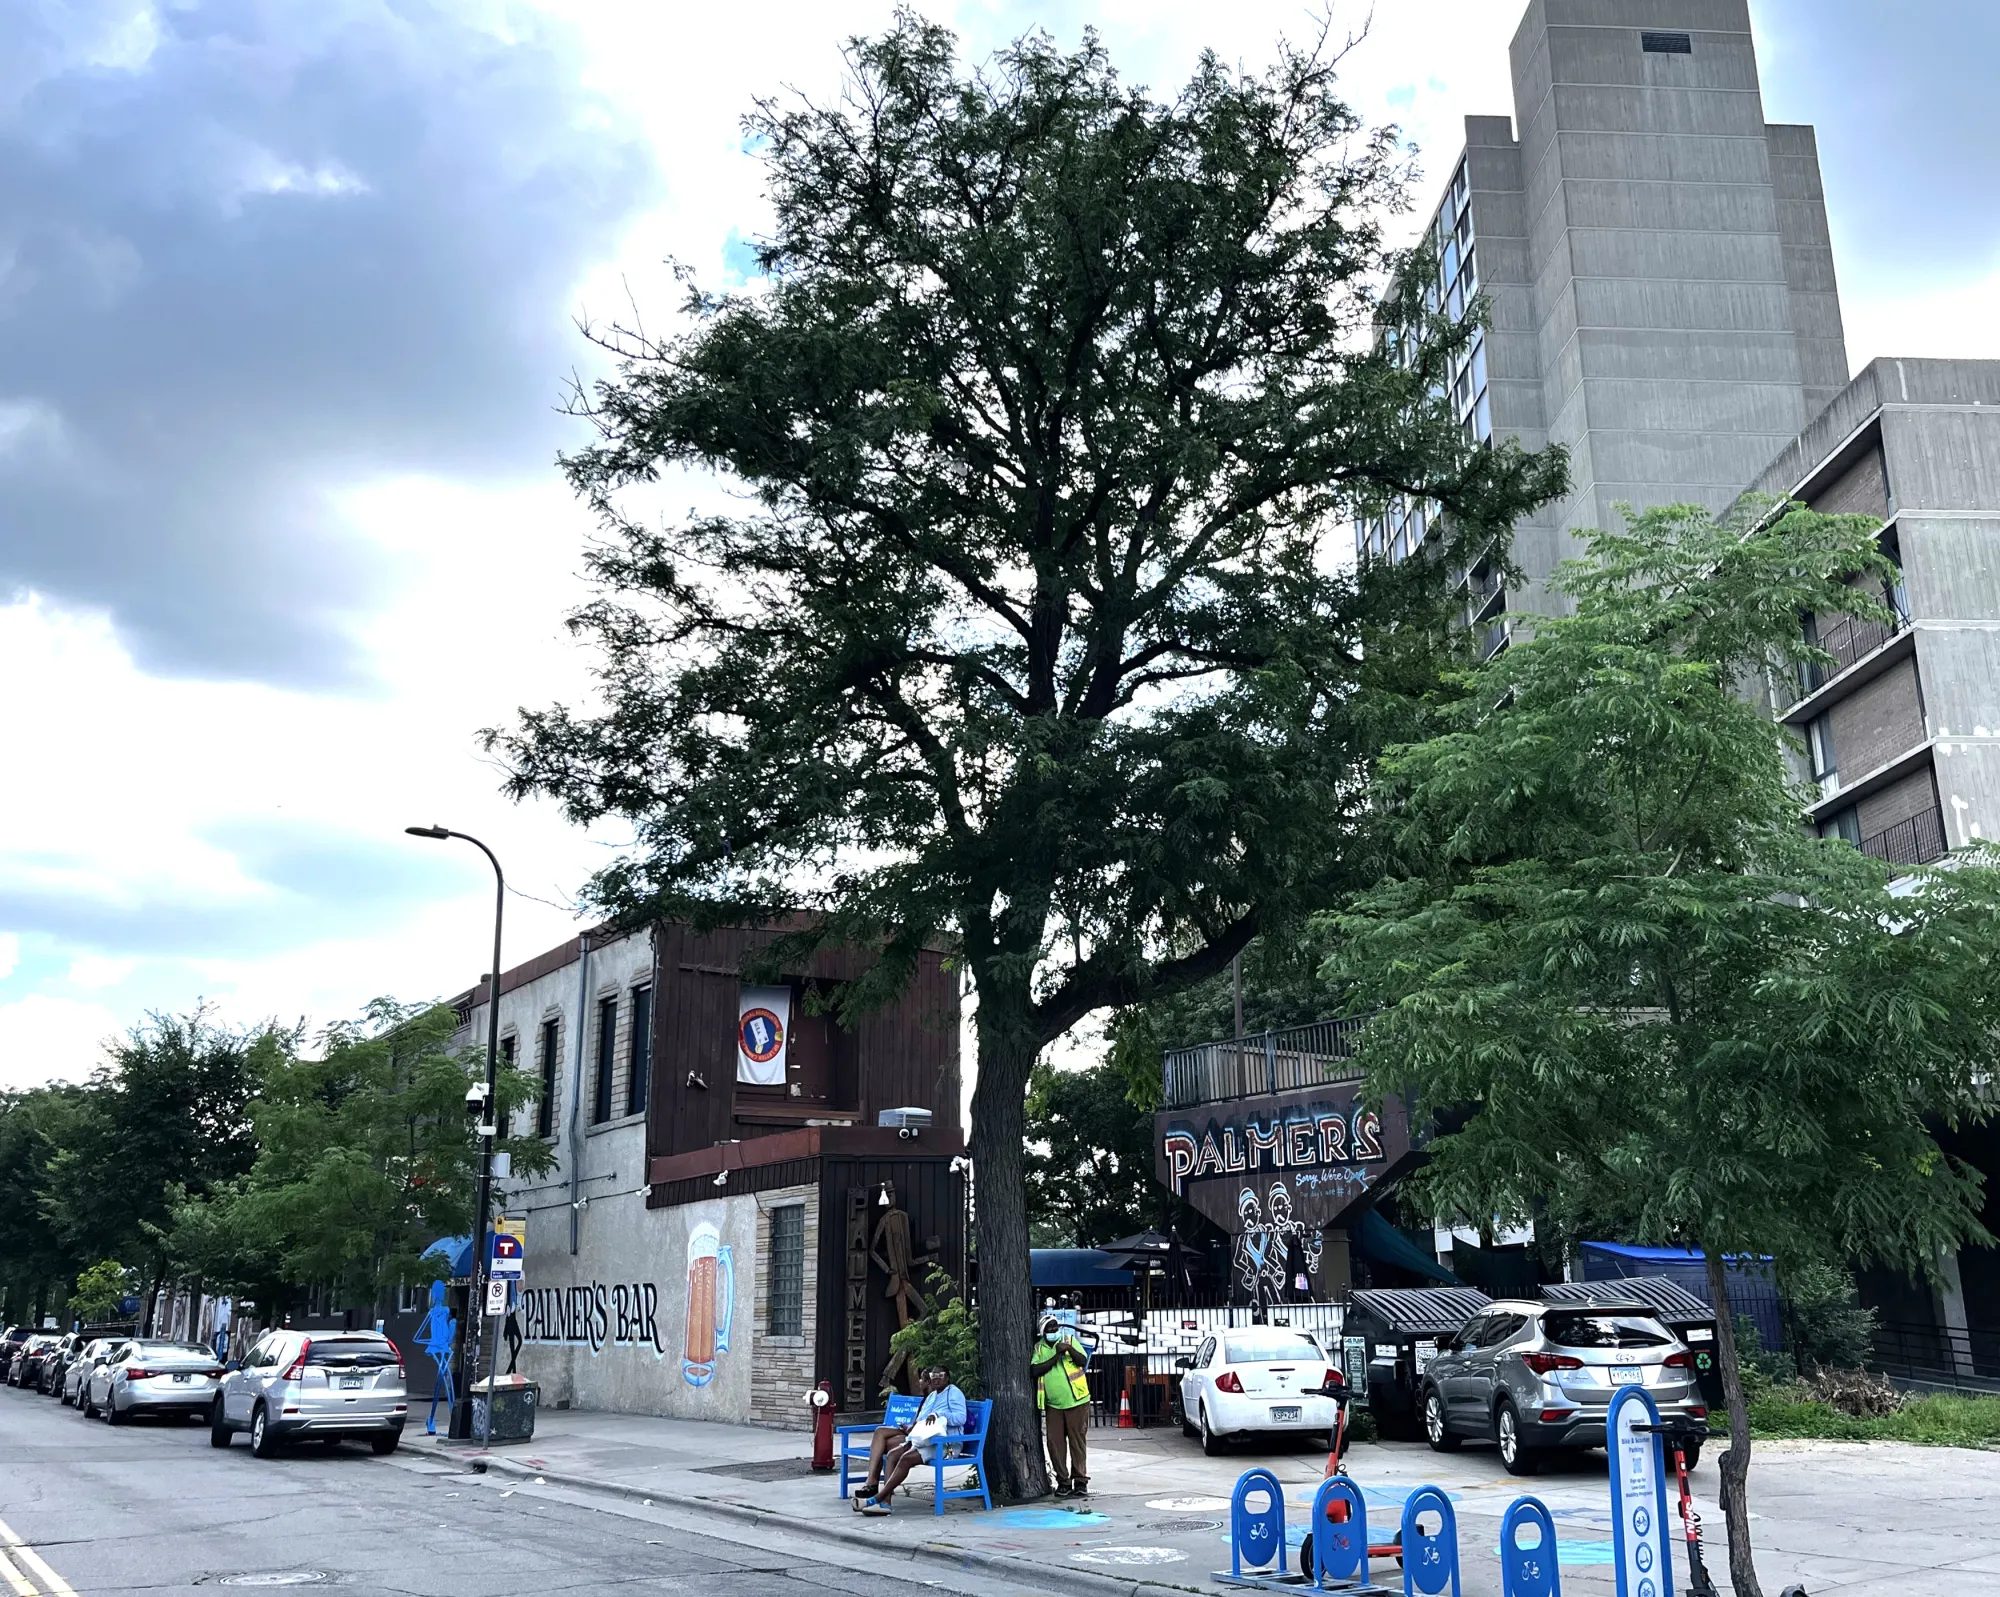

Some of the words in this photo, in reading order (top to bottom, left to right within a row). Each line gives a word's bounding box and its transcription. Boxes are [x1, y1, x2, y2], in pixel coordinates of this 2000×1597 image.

[1165, 1109, 1384, 1197] PALMERS
[521, 1280, 608, 1355] PALMER'S
[611, 1282, 667, 1357] BAR
[847, 1192, 867, 1403] PALMERS
[1629, 1446, 1644, 1454] Parking
[1685, 1502, 1695, 1534] SPIN
